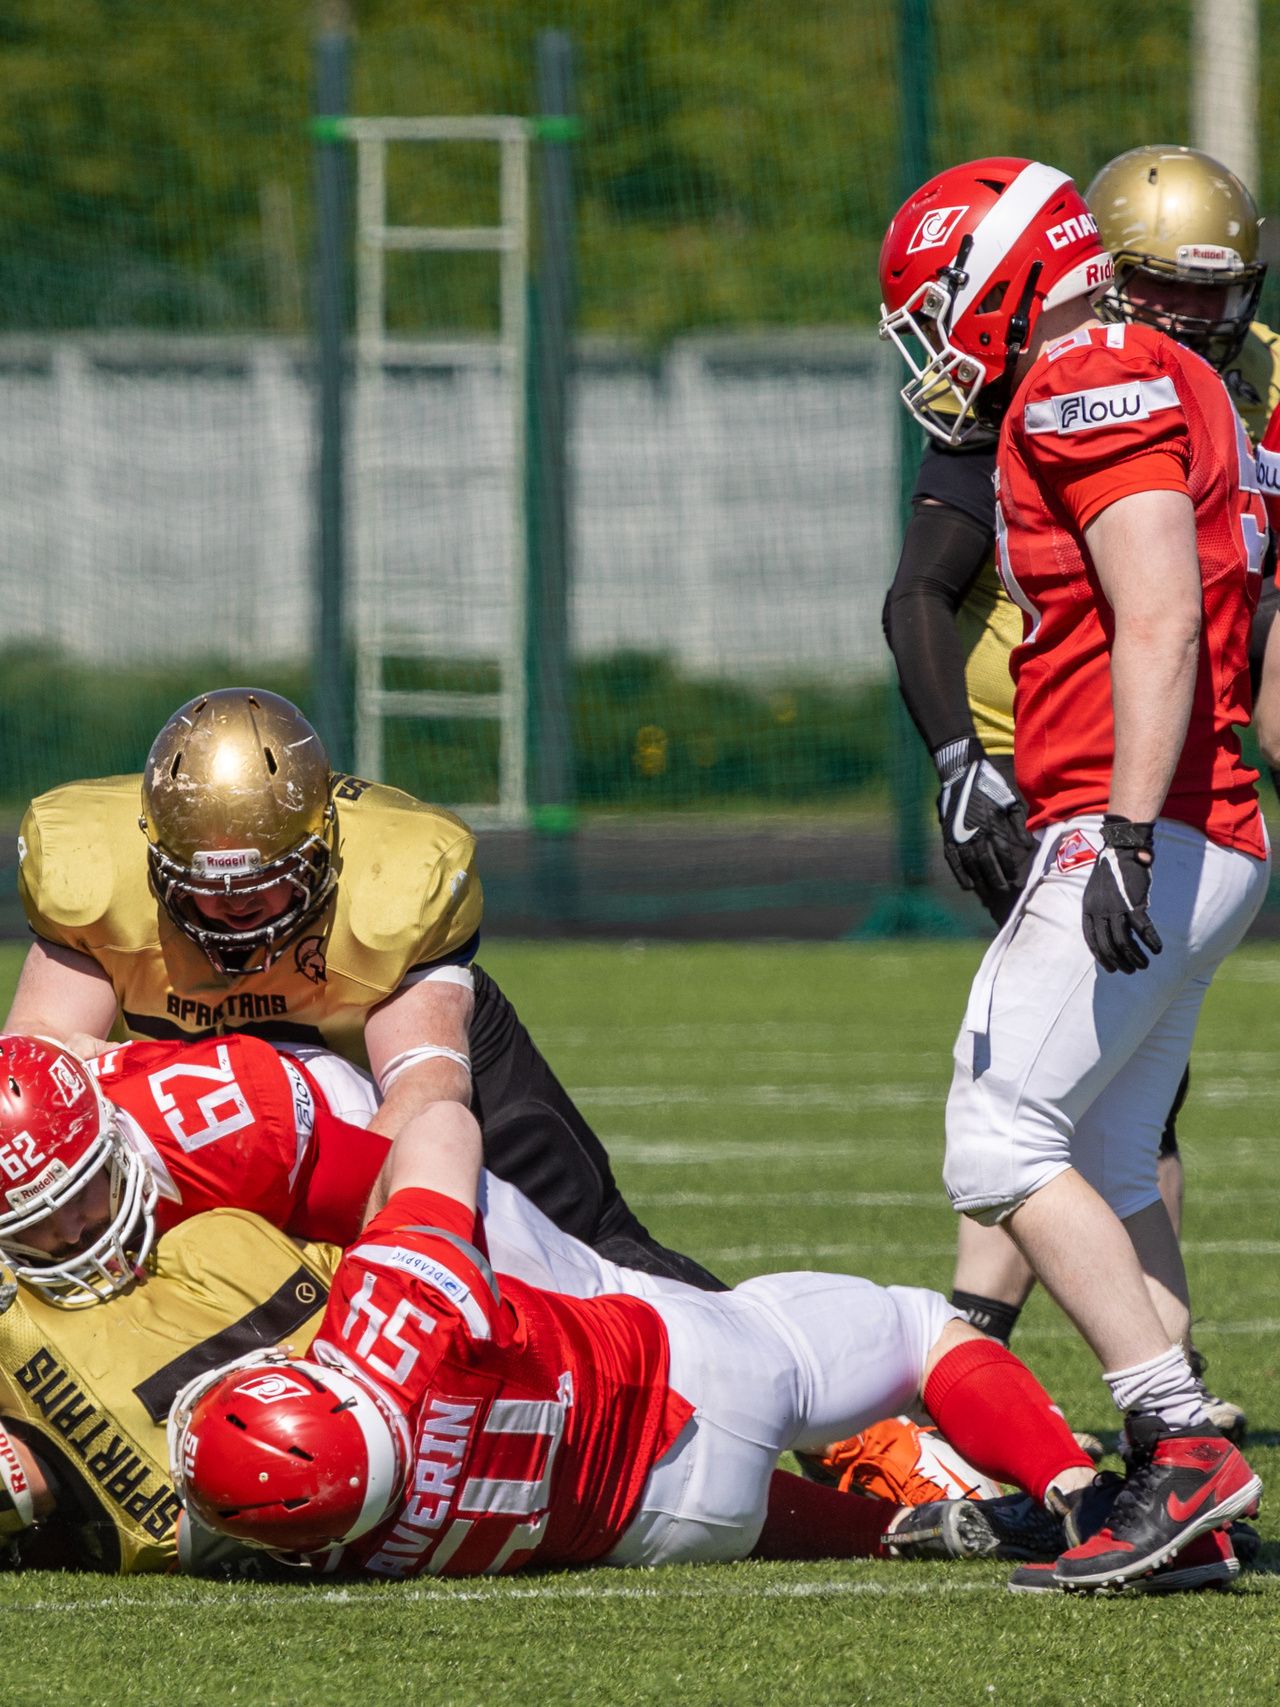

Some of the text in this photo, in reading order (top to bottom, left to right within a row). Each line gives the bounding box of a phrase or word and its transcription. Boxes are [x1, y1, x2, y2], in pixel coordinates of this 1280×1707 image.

[1061, 394, 1141, 428] Flow
[206, 854, 246, 867] Riddell
[20, 1171, 56, 1199] Riddell
[14, 1346, 183, 1540] SPARTANS
[365, 1398, 478, 1577] AVERIN
